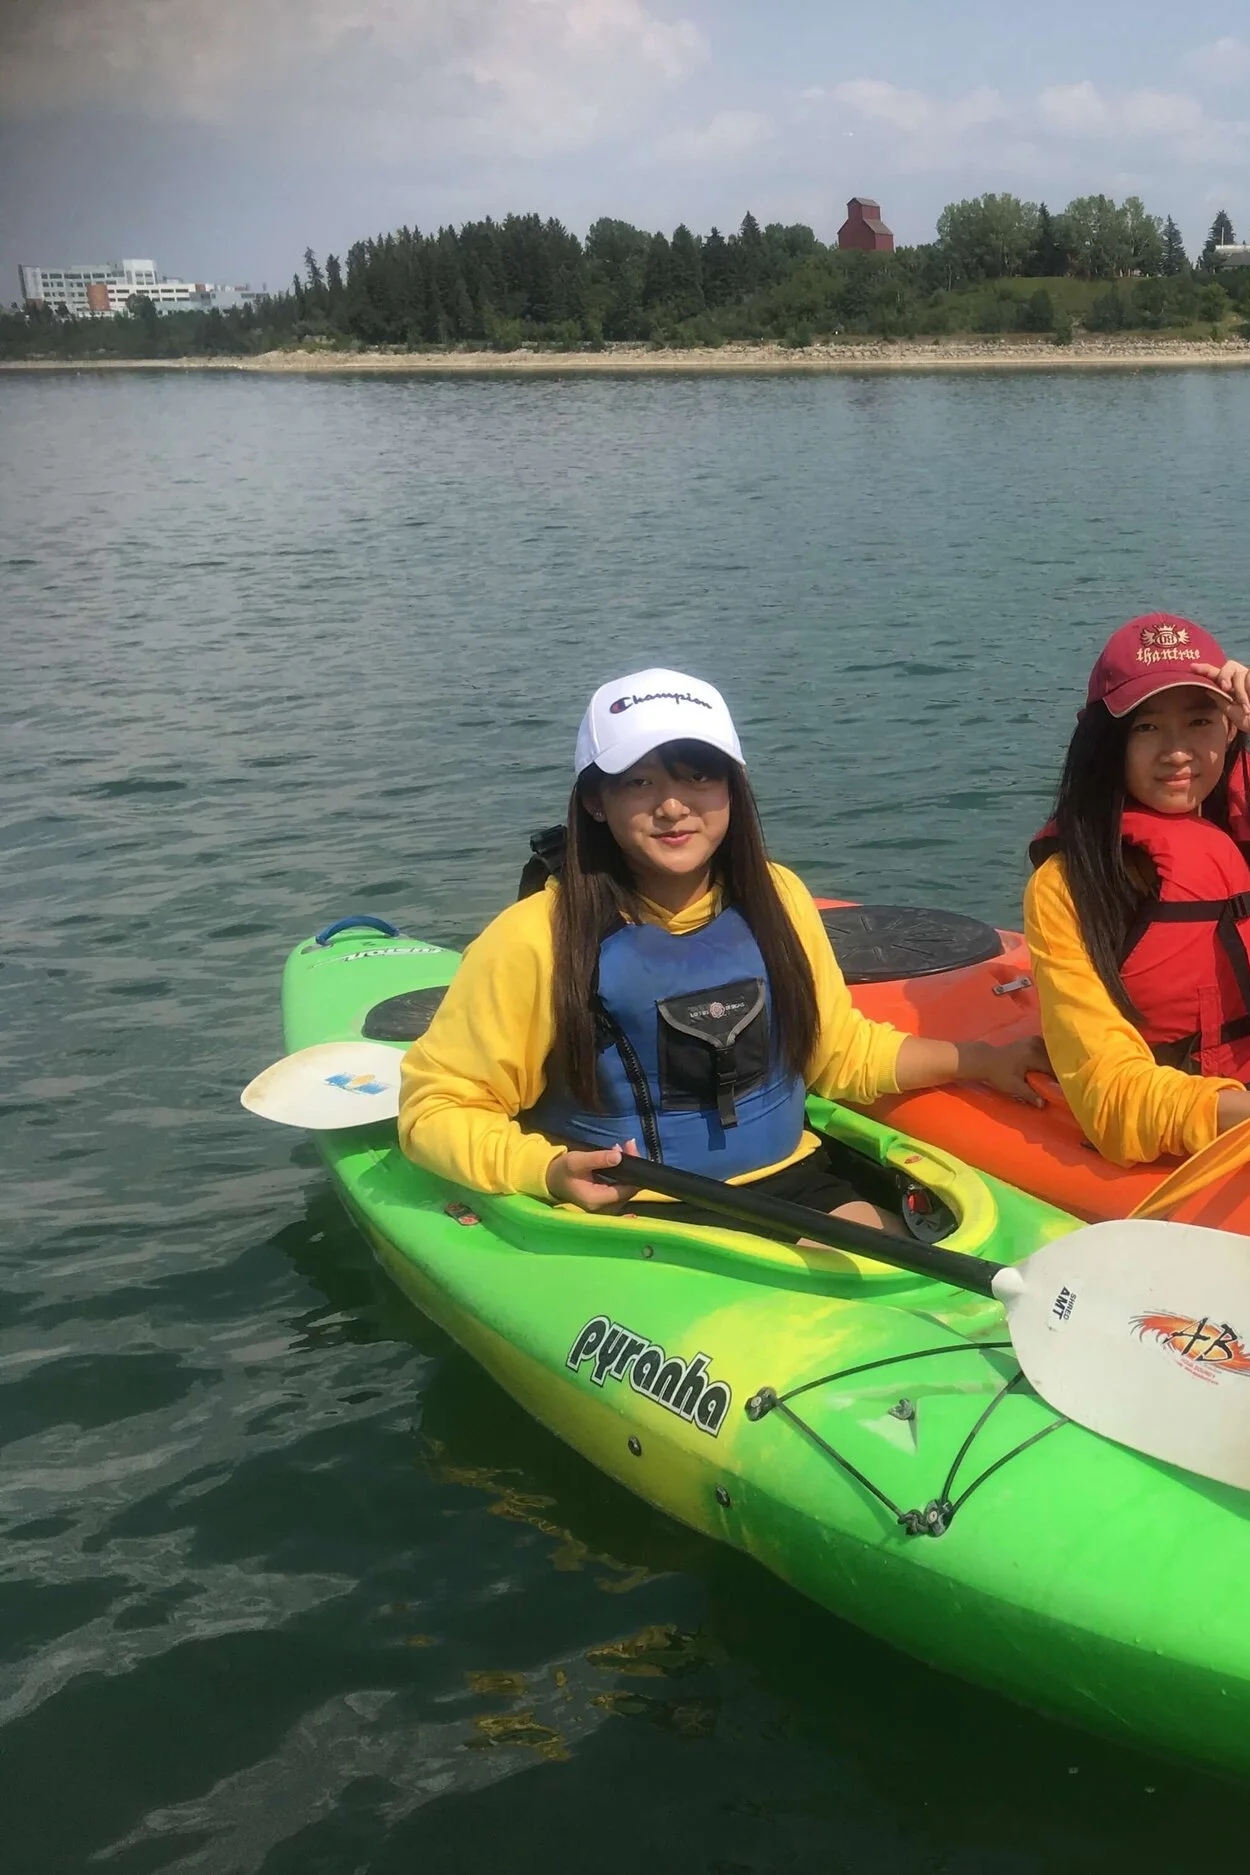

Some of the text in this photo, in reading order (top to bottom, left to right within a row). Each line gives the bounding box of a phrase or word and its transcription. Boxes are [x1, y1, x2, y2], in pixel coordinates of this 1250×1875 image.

[610, 692, 712, 714] Champion
[1052, 1286, 1070, 1320] AMT
[1063, 1293, 1077, 1320] SHRED
[566, 1315, 732, 1438] pyranha
